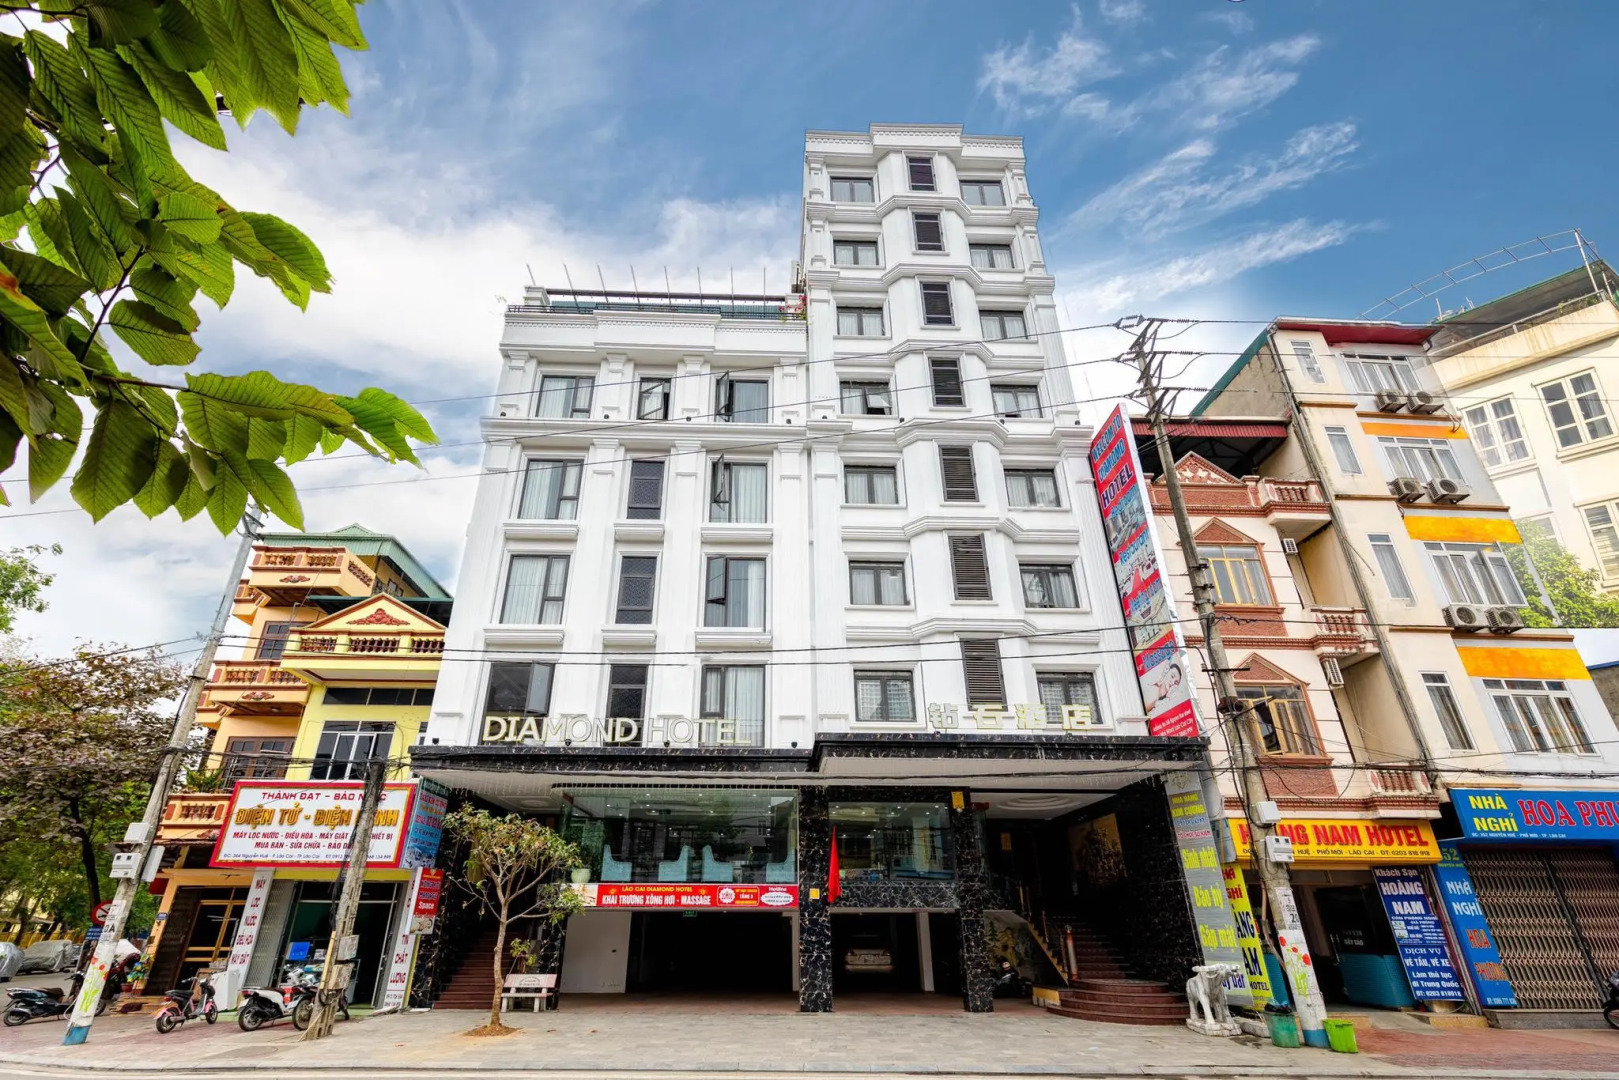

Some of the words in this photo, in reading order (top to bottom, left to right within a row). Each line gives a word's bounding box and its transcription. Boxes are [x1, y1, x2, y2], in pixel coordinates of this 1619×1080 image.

[1112, 413, 1122, 434] TO
[1101, 462, 1135, 509] HOTEL
[928, 702, 1093, 731] 钻石酒店
[482, 716, 638, 742] DIAMOND
[647, 717, 752, 743] HOTEL
[262, 790, 297, 800] THÀNH
[299, 792, 322, 801] ĐẠT
[358, 793, 387, 801] NC
[1468, 793, 1508, 810] NHÀ
[236, 804, 275, 829] ĐIỆN
[278, 801, 304, 827] TỬ
[313, 804, 353, 831] ĐIỆN
[1517, 799, 1577, 827] HOA
[1473, 812, 1519, 832] NGHỈ
[233, 831, 247, 839] MÁY
[319, 832, 334, 840] MÁY
[1238, 823, 1310, 845] HNG
[1311, 824, 1363, 846] NAM
[1364, 824, 1429, 847] HOTEL
[270, 841, 285, 849] BÁN
[1442, 848, 1460, 861] 52
[1222, 865, 1236, 881] HÀ
[1374, 868, 1401, 877] Khách
[1401, 868, 1418, 878] Sạn
[1380, 879, 1424, 896] HOÀNG
[1446, 878, 1473, 895] NHÀ
[602, 894, 618, 905] KHAI
[680, 895, 712, 905] MASSAGE
[1391, 901, 1426, 915] NAM
[1466, 929, 1491, 949] HOA
[1404, 948, 1427, 956] DỊCH
[1428, 948, 1442, 956] VỤ
[1242, 946, 1263, 977] AM
[1440, 958, 1452, 967] XE
[1440, 980, 1460, 988] Quốc
